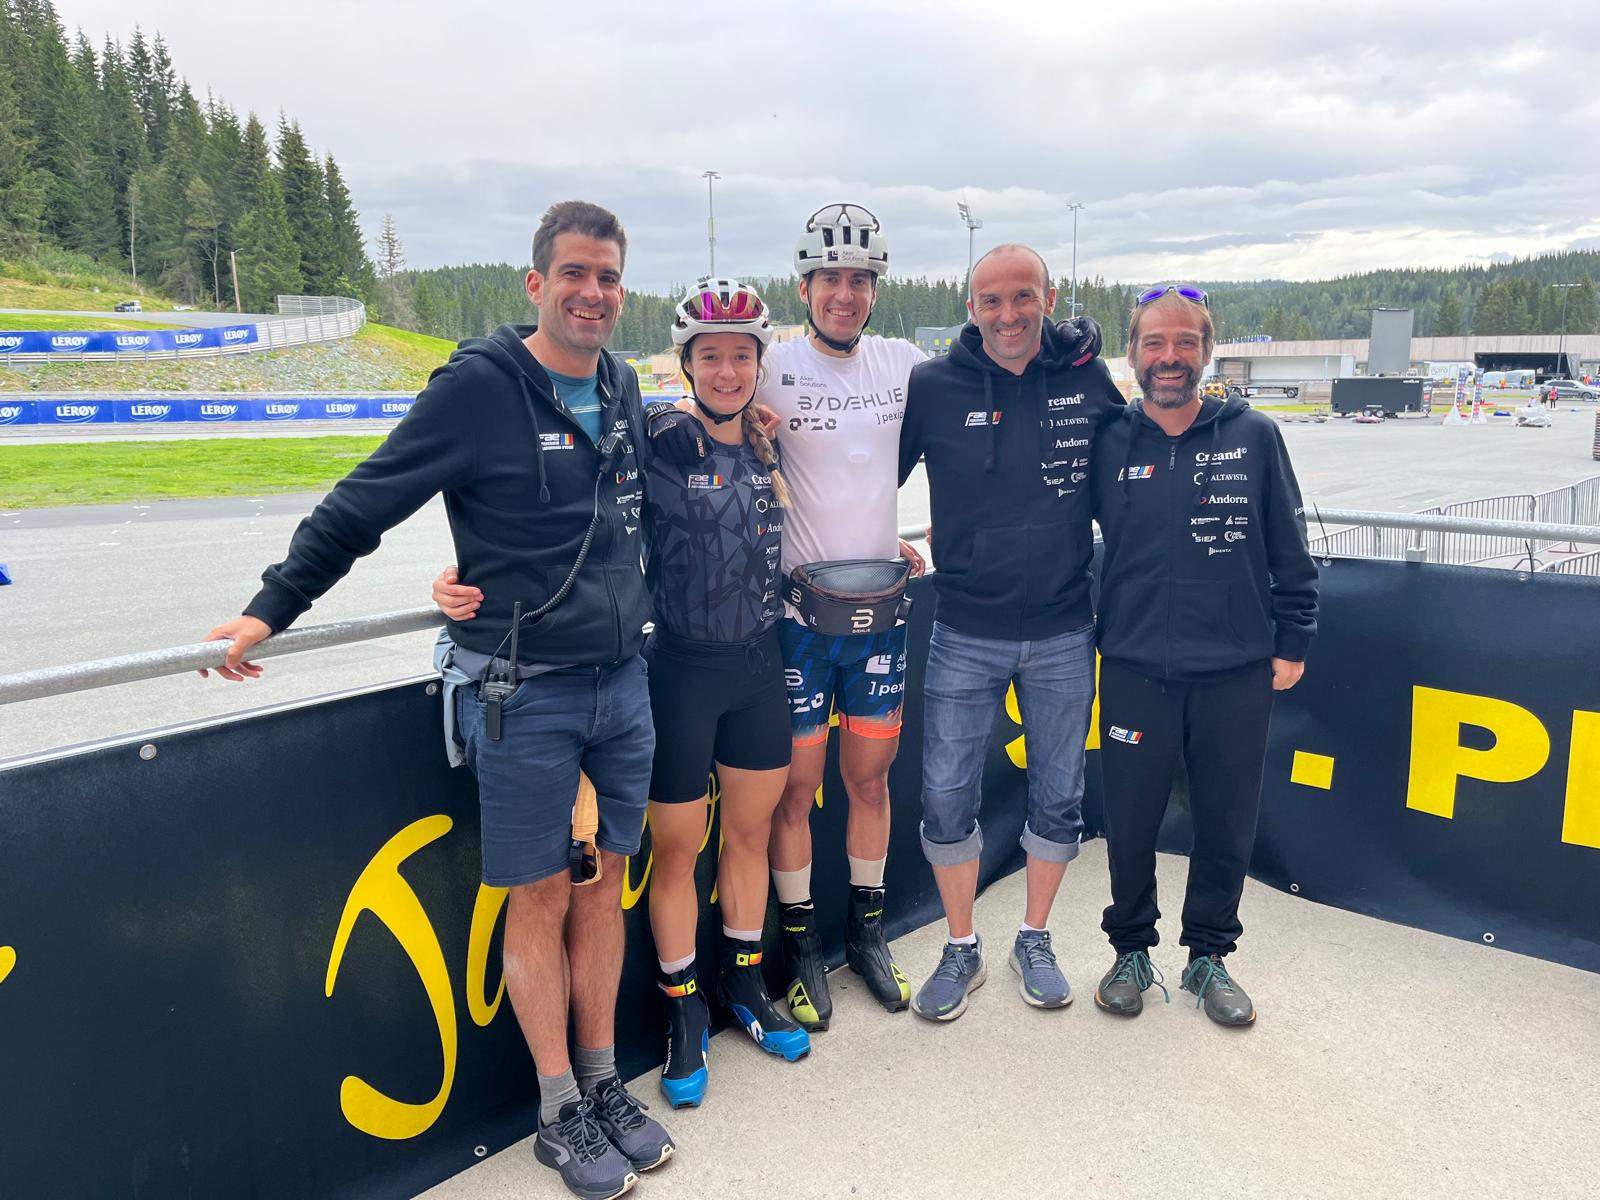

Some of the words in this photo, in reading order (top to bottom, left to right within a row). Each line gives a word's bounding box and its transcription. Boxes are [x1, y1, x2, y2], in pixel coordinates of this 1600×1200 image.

[175, 333, 201, 344] LERØY
[224, 330, 249, 340] LERØY
[52, 336, 88, 347] LERØY
[117, 336, 150, 346] LERØY
[56, 405, 97, 417] LERØY
[131, 404, 170, 416] LERØY
[201, 404, 238, 415] LERØY
[266, 404, 299, 414] LERØY
[326, 404, 357, 413] LERØY
[1055, 417, 1089, 427] ALTAVISTA
[1055, 437, 1089, 448] Andorra
[1210, 473, 1248, 481] ALTAVISTA
[1208, 494, 1248, 504] Andorra
